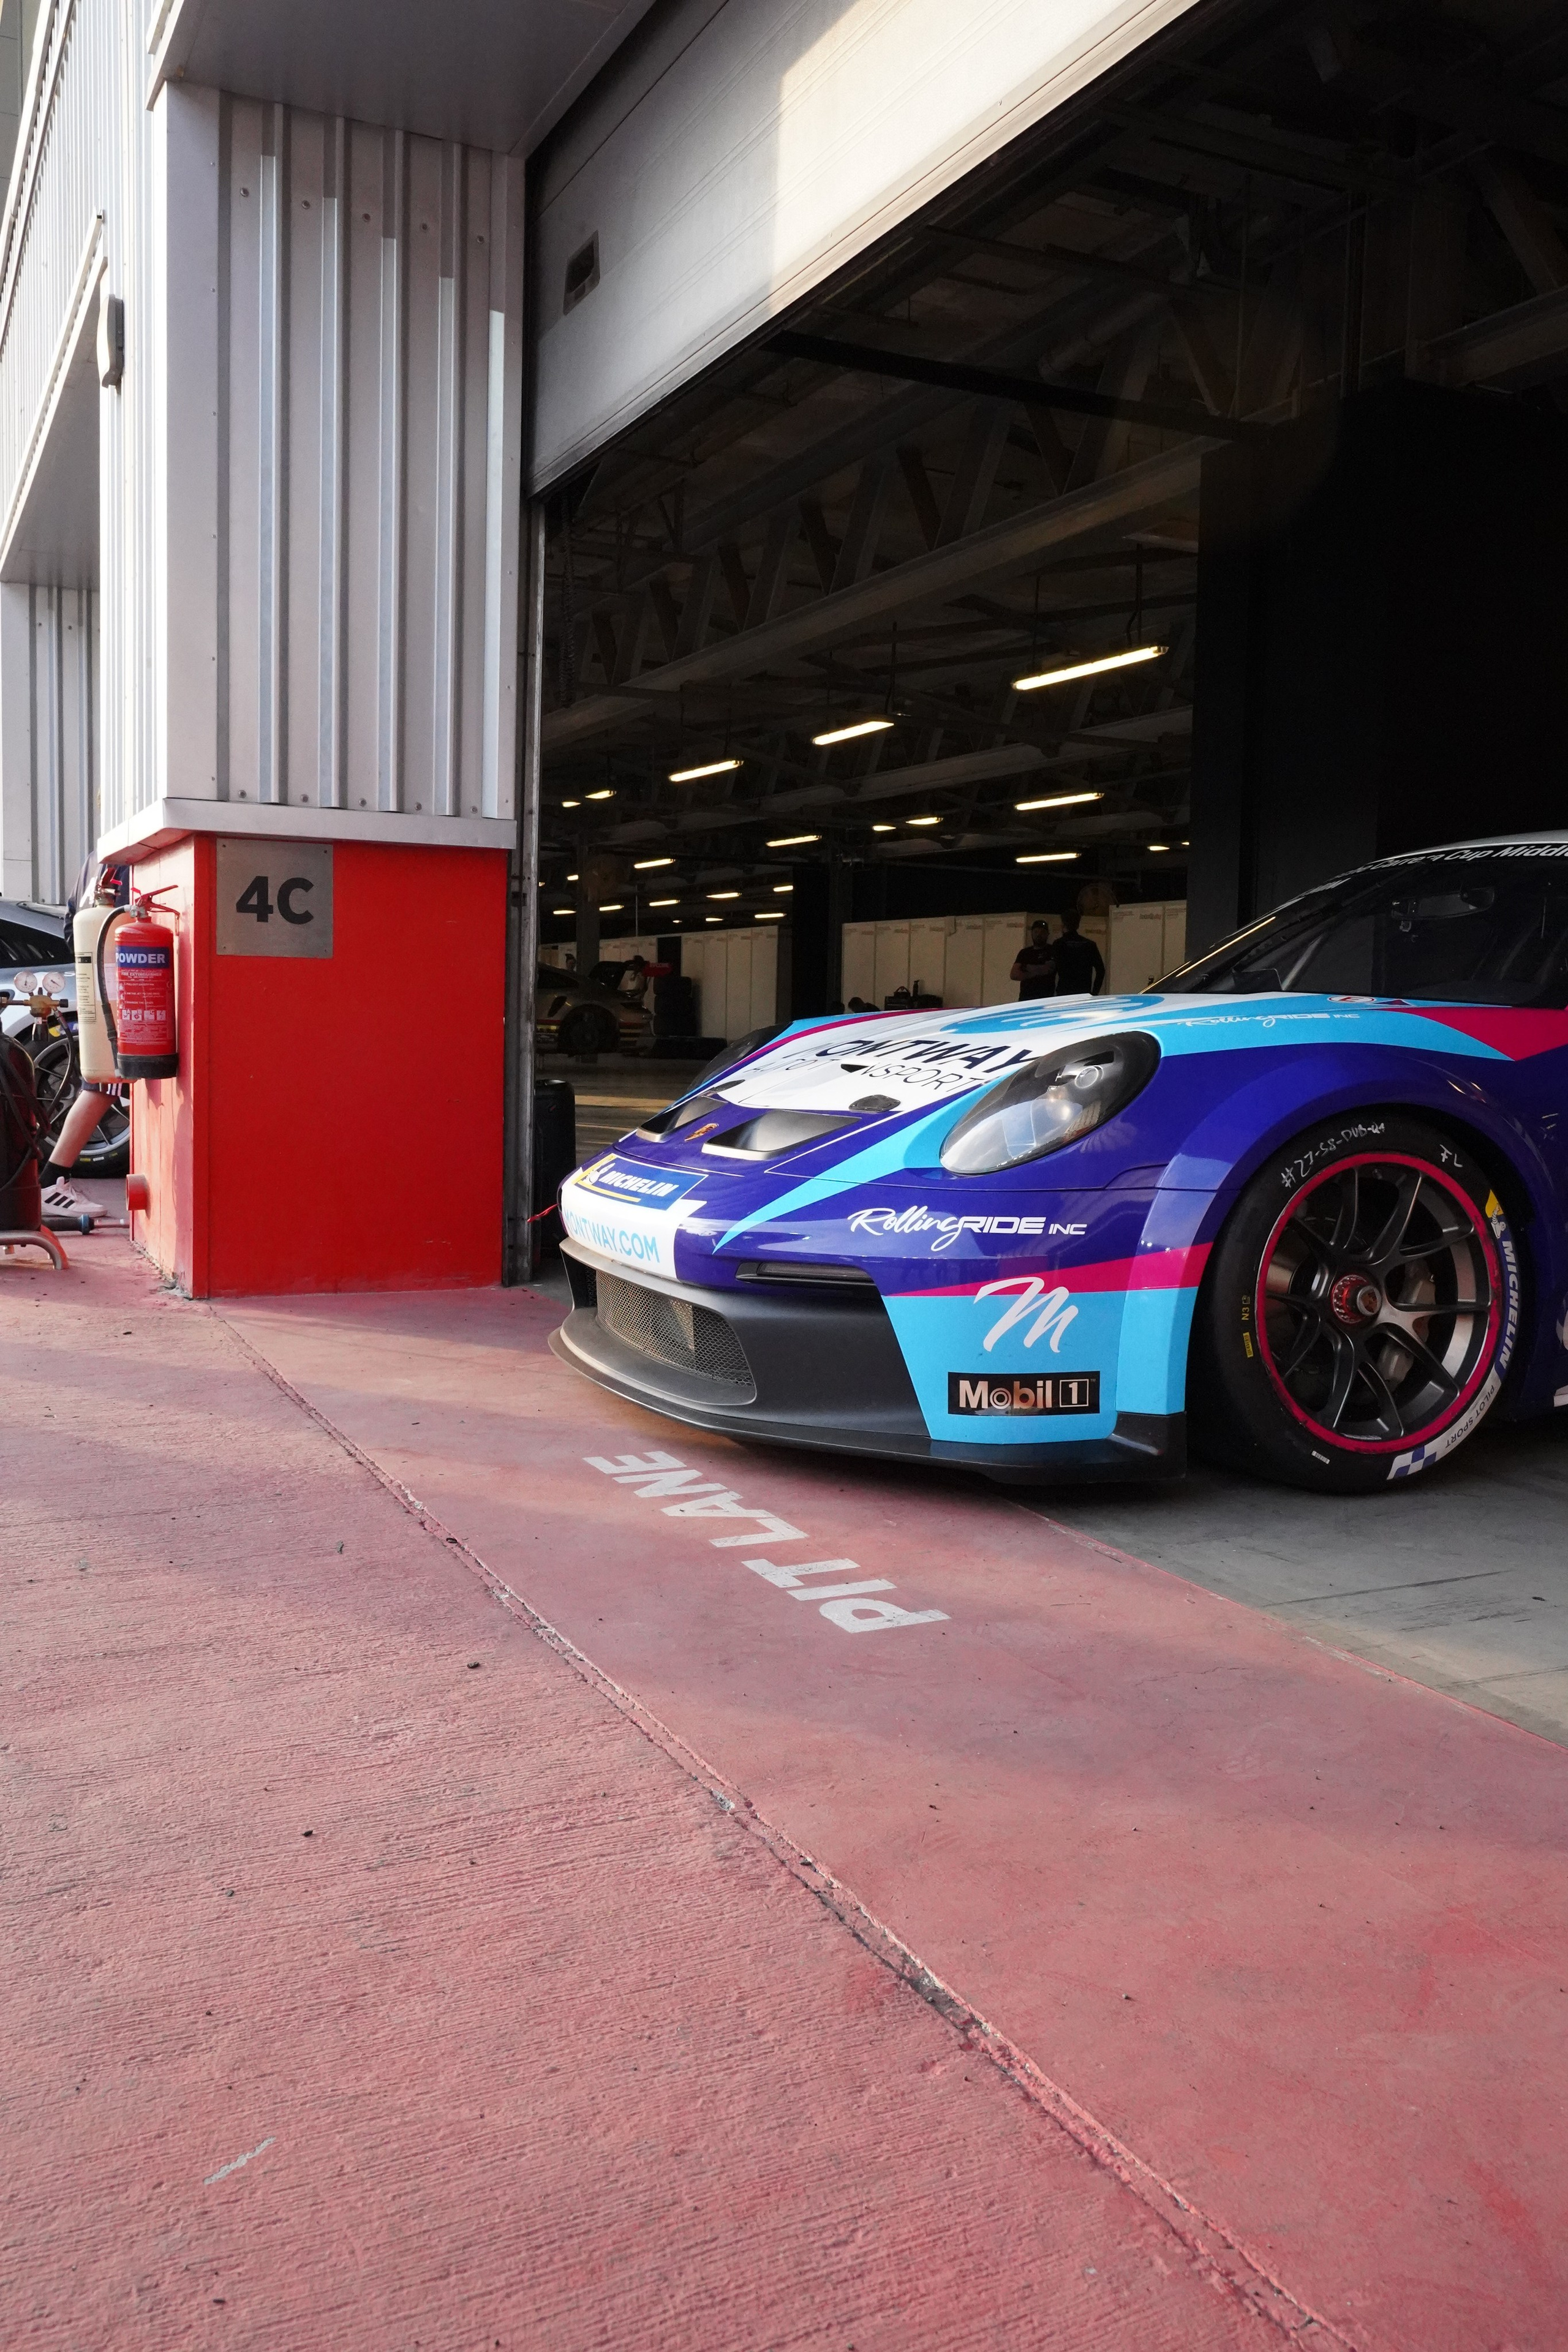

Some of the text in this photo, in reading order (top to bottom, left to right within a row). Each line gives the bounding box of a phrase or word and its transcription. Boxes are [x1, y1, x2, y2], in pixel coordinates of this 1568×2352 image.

[1444, 849, 1494, 861] Cup
[1491, 845, 1568, 857] Middl
[236, 876, 315, 925] 4C
[116, 952, 165, 963] POWDER
[744, 1058, 985, 1092] AUTO TNSPORT
[1439, 1144, 1463, 1168] FL
[600, 1170, 679, 1197] MICHELIN
[564, 1208, 660, 1263] MONTWAY.COM
[1048, 1223, 1087, 1235] INC
[1499, 1240, 1519, 1370] MICHELIN
[959, 1379, 1052, 1409] Mobil
[1476, 1384, 1494, 1418] PILOT
[1446, 1417, 1473, 1449] SPORT
[582, 1450, 951, 1634] PIT LANE
